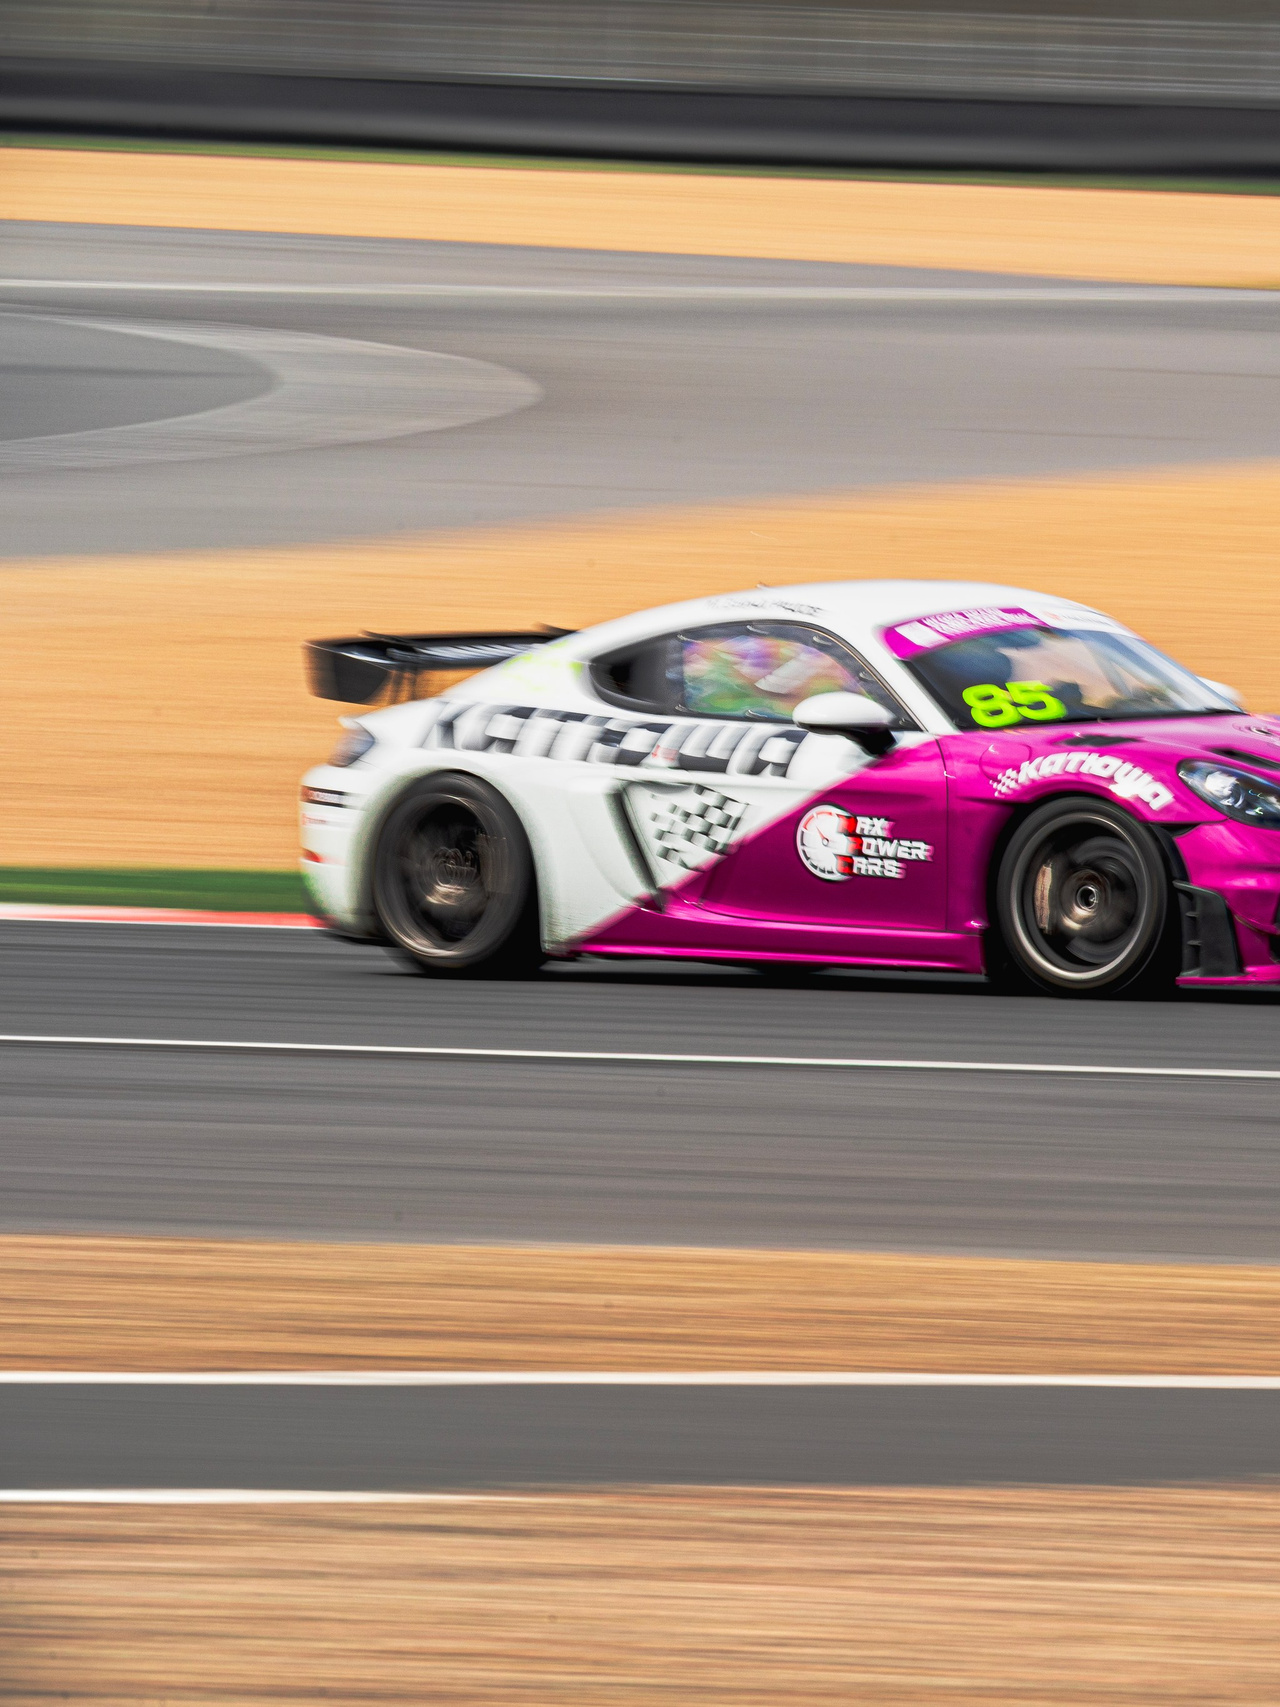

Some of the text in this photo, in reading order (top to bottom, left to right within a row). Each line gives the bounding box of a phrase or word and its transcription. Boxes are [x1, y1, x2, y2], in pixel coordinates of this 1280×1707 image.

[962, 680, 1067, 728] 85
[847, 836, 934, 861] POWER
[836, 854, 907, 879] CARS
